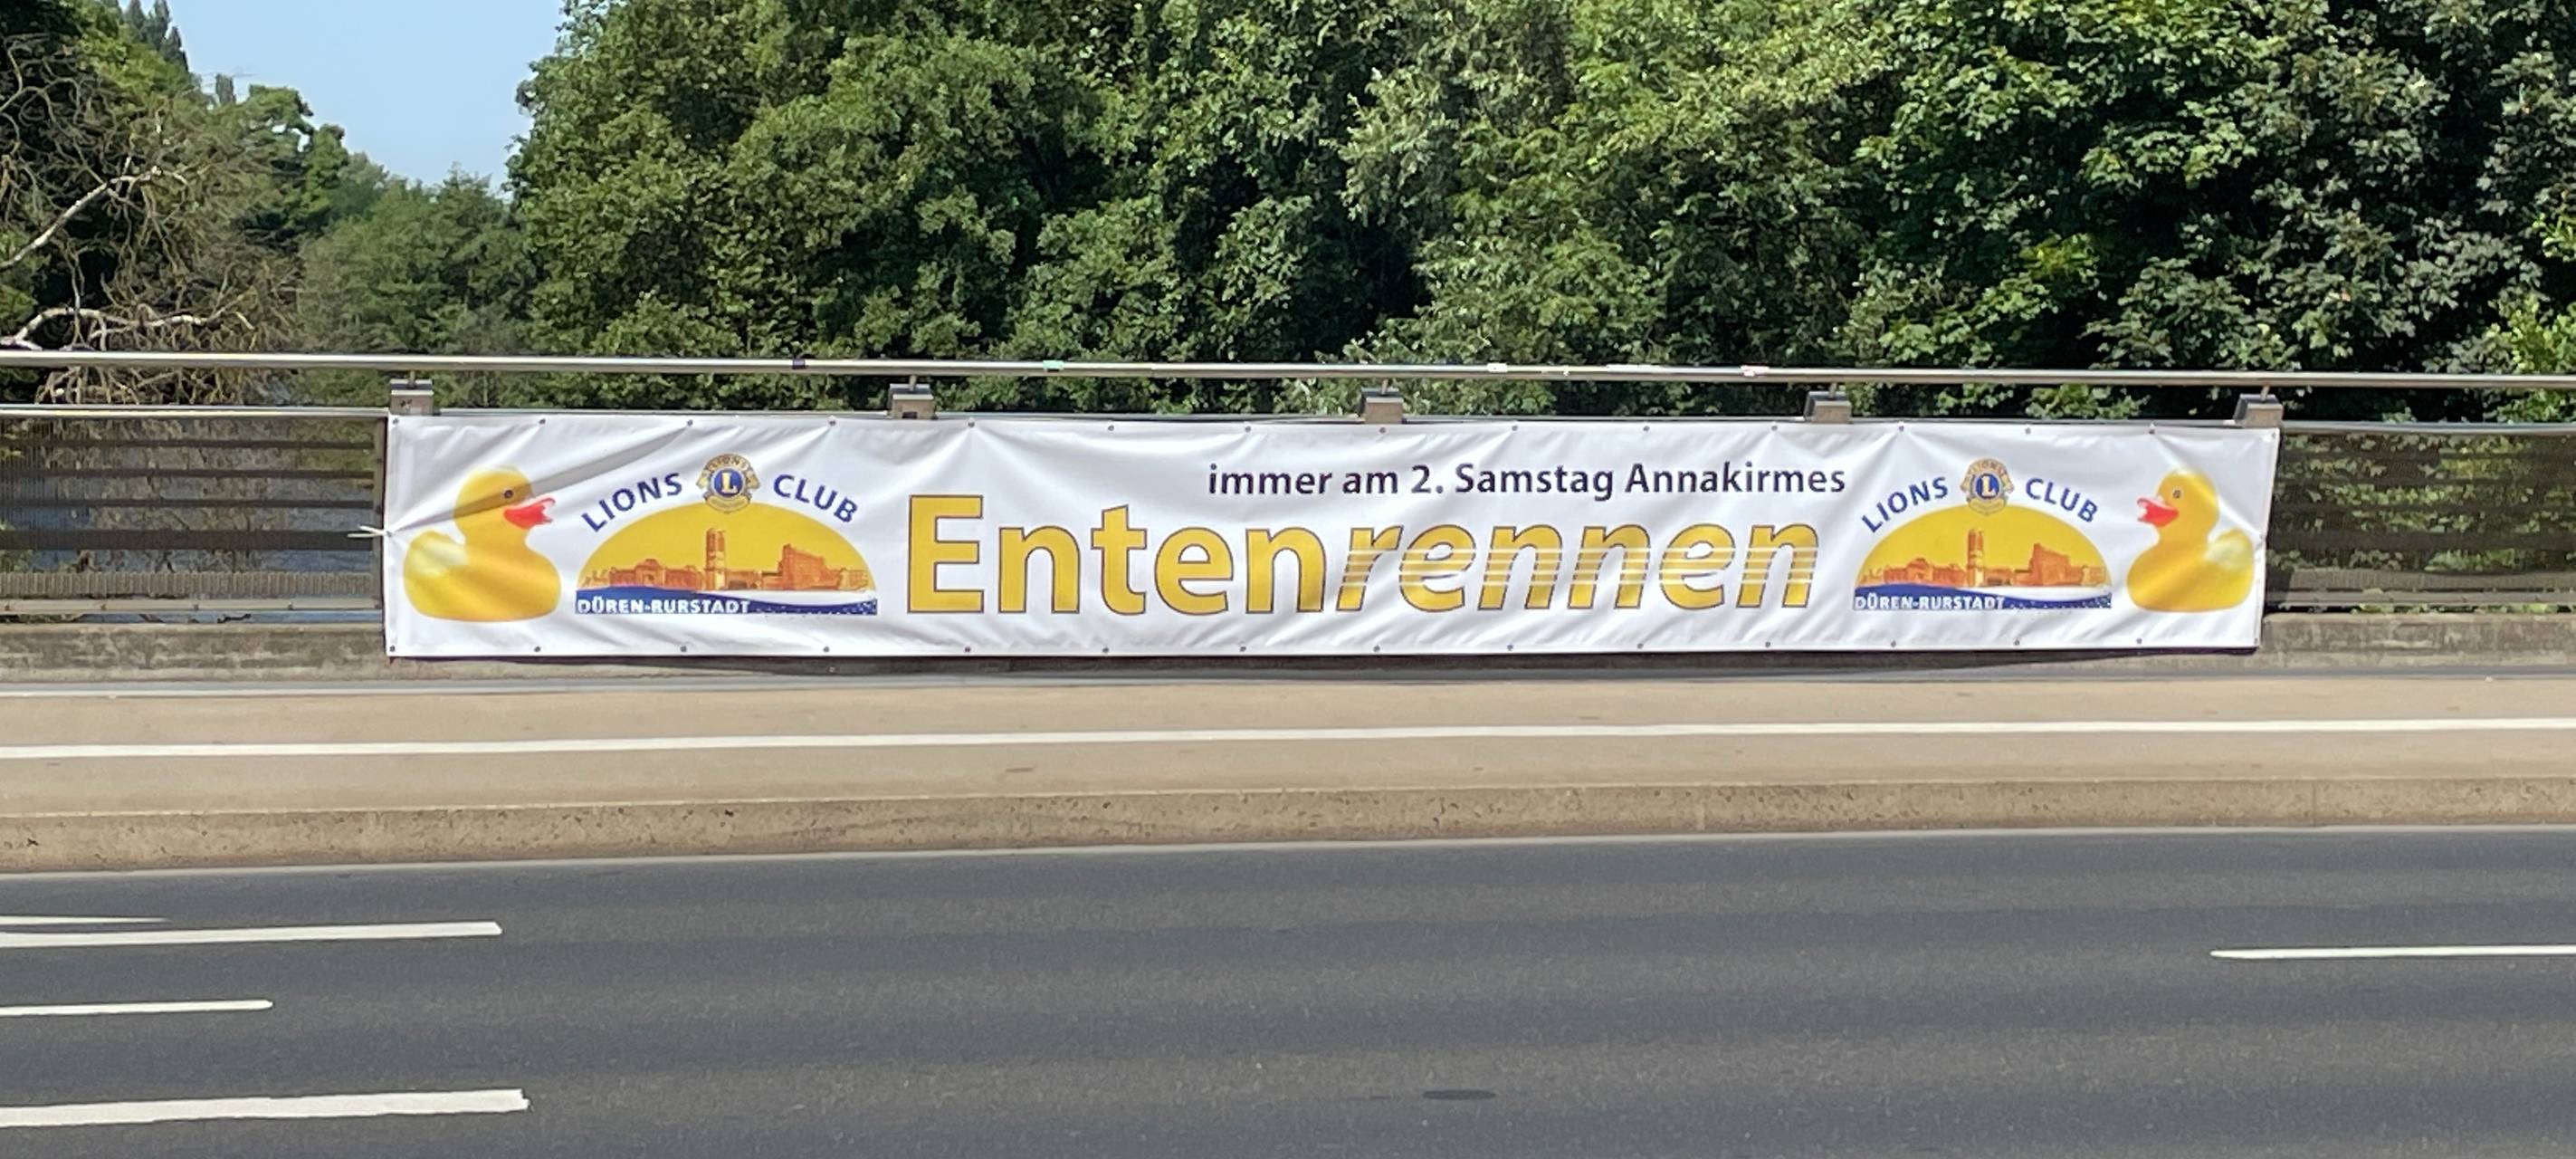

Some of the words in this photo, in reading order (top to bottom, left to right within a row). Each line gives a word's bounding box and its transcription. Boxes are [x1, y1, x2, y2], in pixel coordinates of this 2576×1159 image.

[721, 472, 739, 494] L
[1208, 464, 1331, 494] immer
[1342, 471, 1398, 494] am
[1411, 465, 1444, 493] 2.
[1455, 464, 1614, 502] Samstag
[1625, 462, 1846, 493] Annakirmes
[1981, 475, 1997, 496] L
[581, 472, 682, 532] LIONS
[773, 474, 859, 523] CLUB
[1862, 476, 1948, 532] LIONS
[2026, 478, 2098, 522] CLUB
[907, 494, 1818, 614] Entenrennen
[577, 598, 751, 614] DÜREN-RURSTADT
[1855, 593, 2005, 609] DÜREN-RURSTADT
